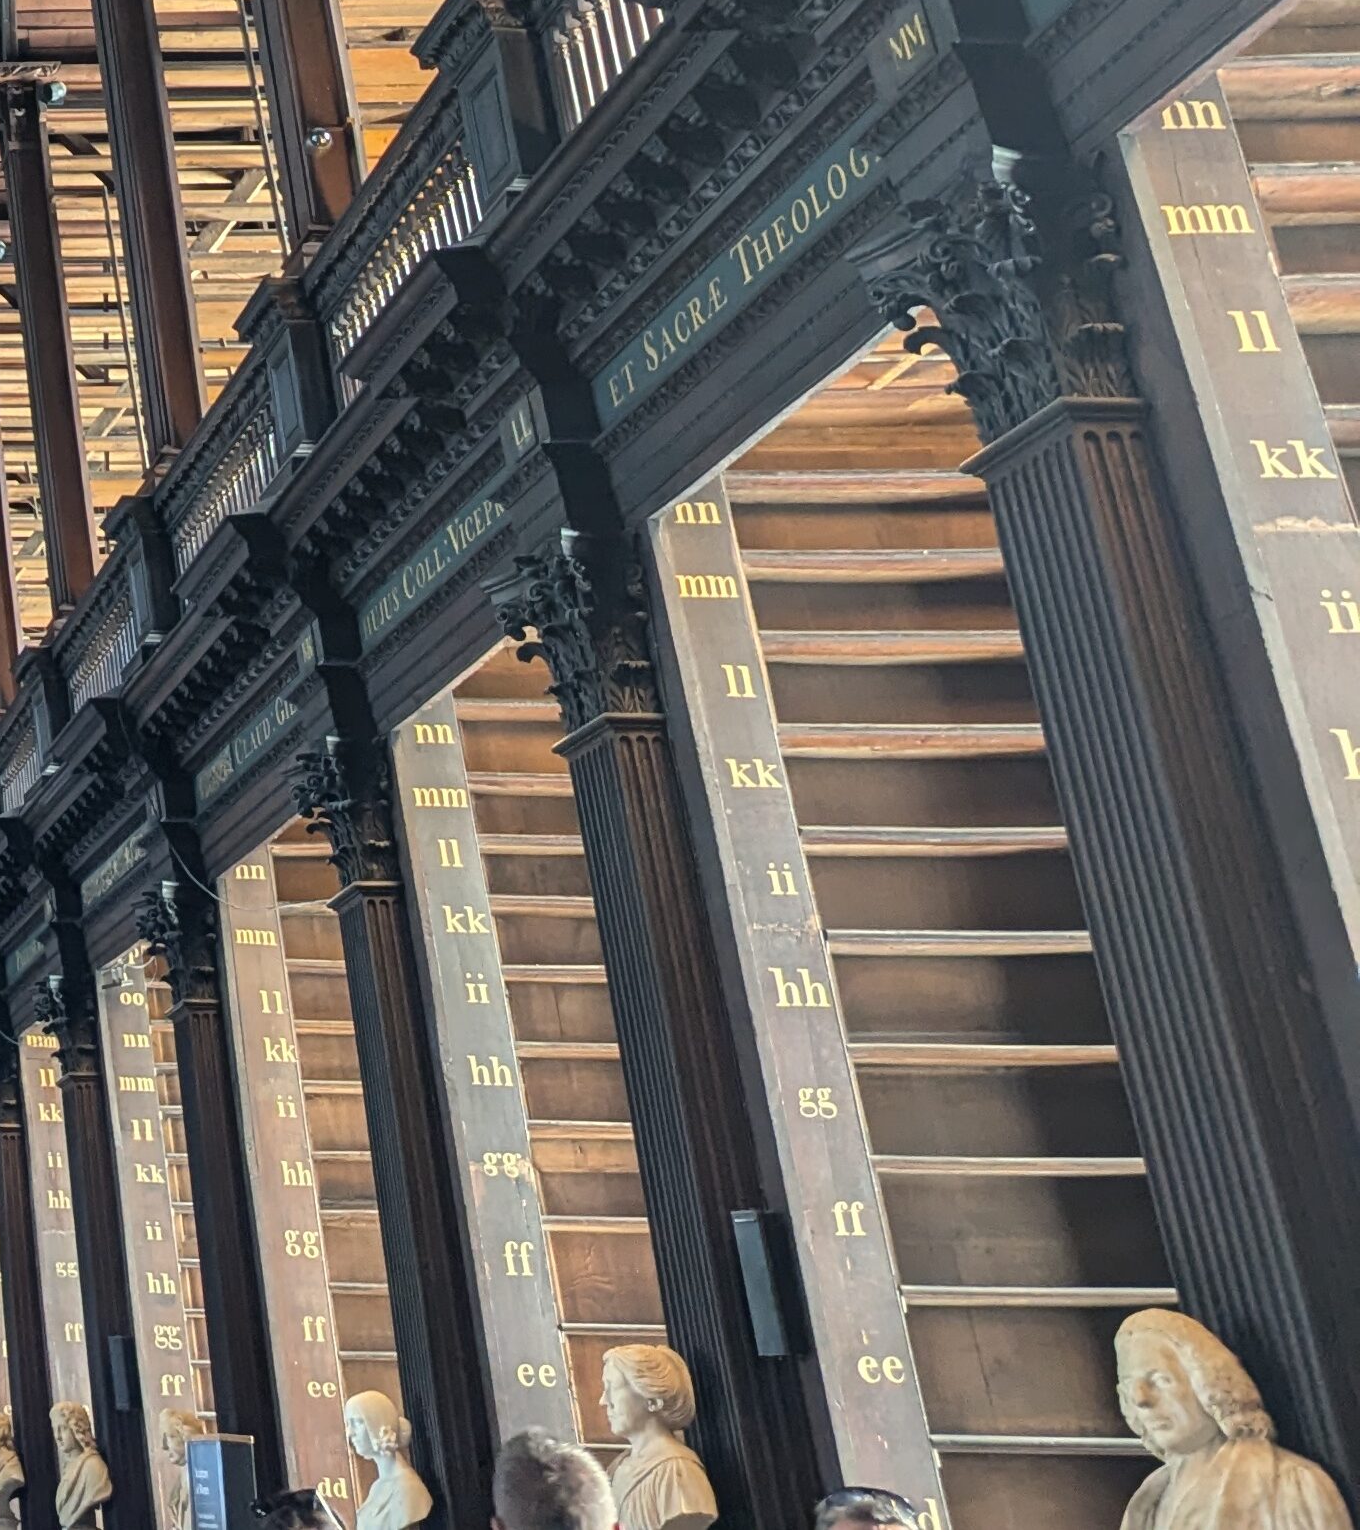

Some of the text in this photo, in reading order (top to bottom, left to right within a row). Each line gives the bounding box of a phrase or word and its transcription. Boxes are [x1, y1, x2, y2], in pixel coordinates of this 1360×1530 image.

[1161, 202, 1256, 235] mm
[1226, 310, 1281, 353] ll
[608, 359, 637, 408] ET
[1250, 439, 1338, 480] kk
[674, 501, 722, 524] nn
[675, 573, 740, 598] mm
[721, 664, 757, 698] ll
[414, 722, 455, 745] nn
[725, 758, 783, 788] kk
[413, 786, 469, 808] mm
[437, 838, 464, 868] ll
[235, 863, 266, 880] nn
[766, 862, 799, 896] ii
[442, 905, 490, 934] kk
[235, 928, 277, 947] mm
[120, 992, 145, 1006] oo
[465, 972, 491, 1005] ii
[768, 967, 831, 1008] hh
[259, 989, 288, 1015] ll
[26, 1033, 60, 1050] mm
[123, 1033, 150, 1048] nn
[263, 1037, 297, 1063] kk
[39, 1068, 56, 1087] ll
[119, 1075, 155, 1092] mm
[467, 1055, 514, 1088] hh
[38, 1103, 64, 1123] kk
[275, 1094, 298, 1119] ii
[798, 1086, 838, 1119] gg
[131, 1118, 153, 1141] ll
[47, 1152, 63, 1169] ii
[482, 1151, 522, 1178] gg
[135, 1163, 165, 1184] kk
[281, 1160, 314, 1187] hh
[47, 1190, 72, 1209] hh
[144, 1220, 162, 1241] ii
[832, 1200, 867, 1236] ff
[284, 1228, 320, 1259] gg
[56, 1261, 78, 1279] gg
[503, 1241, 534, 1277] ff
[146, 1272, 177, 1295] hh
[64, 1322, 83, 1343] ff
[153, 1323, 183, 1350] gg
[301, 1316, 326, 1343] ff
[517, 1362, 558, 1388] ee
[857, 1353, 906, 1384] ee
[160, 1374, 186, 1397] ff
[307, 1380, 337, 1399] ee
[316, 1476, 348, 1500] dd
